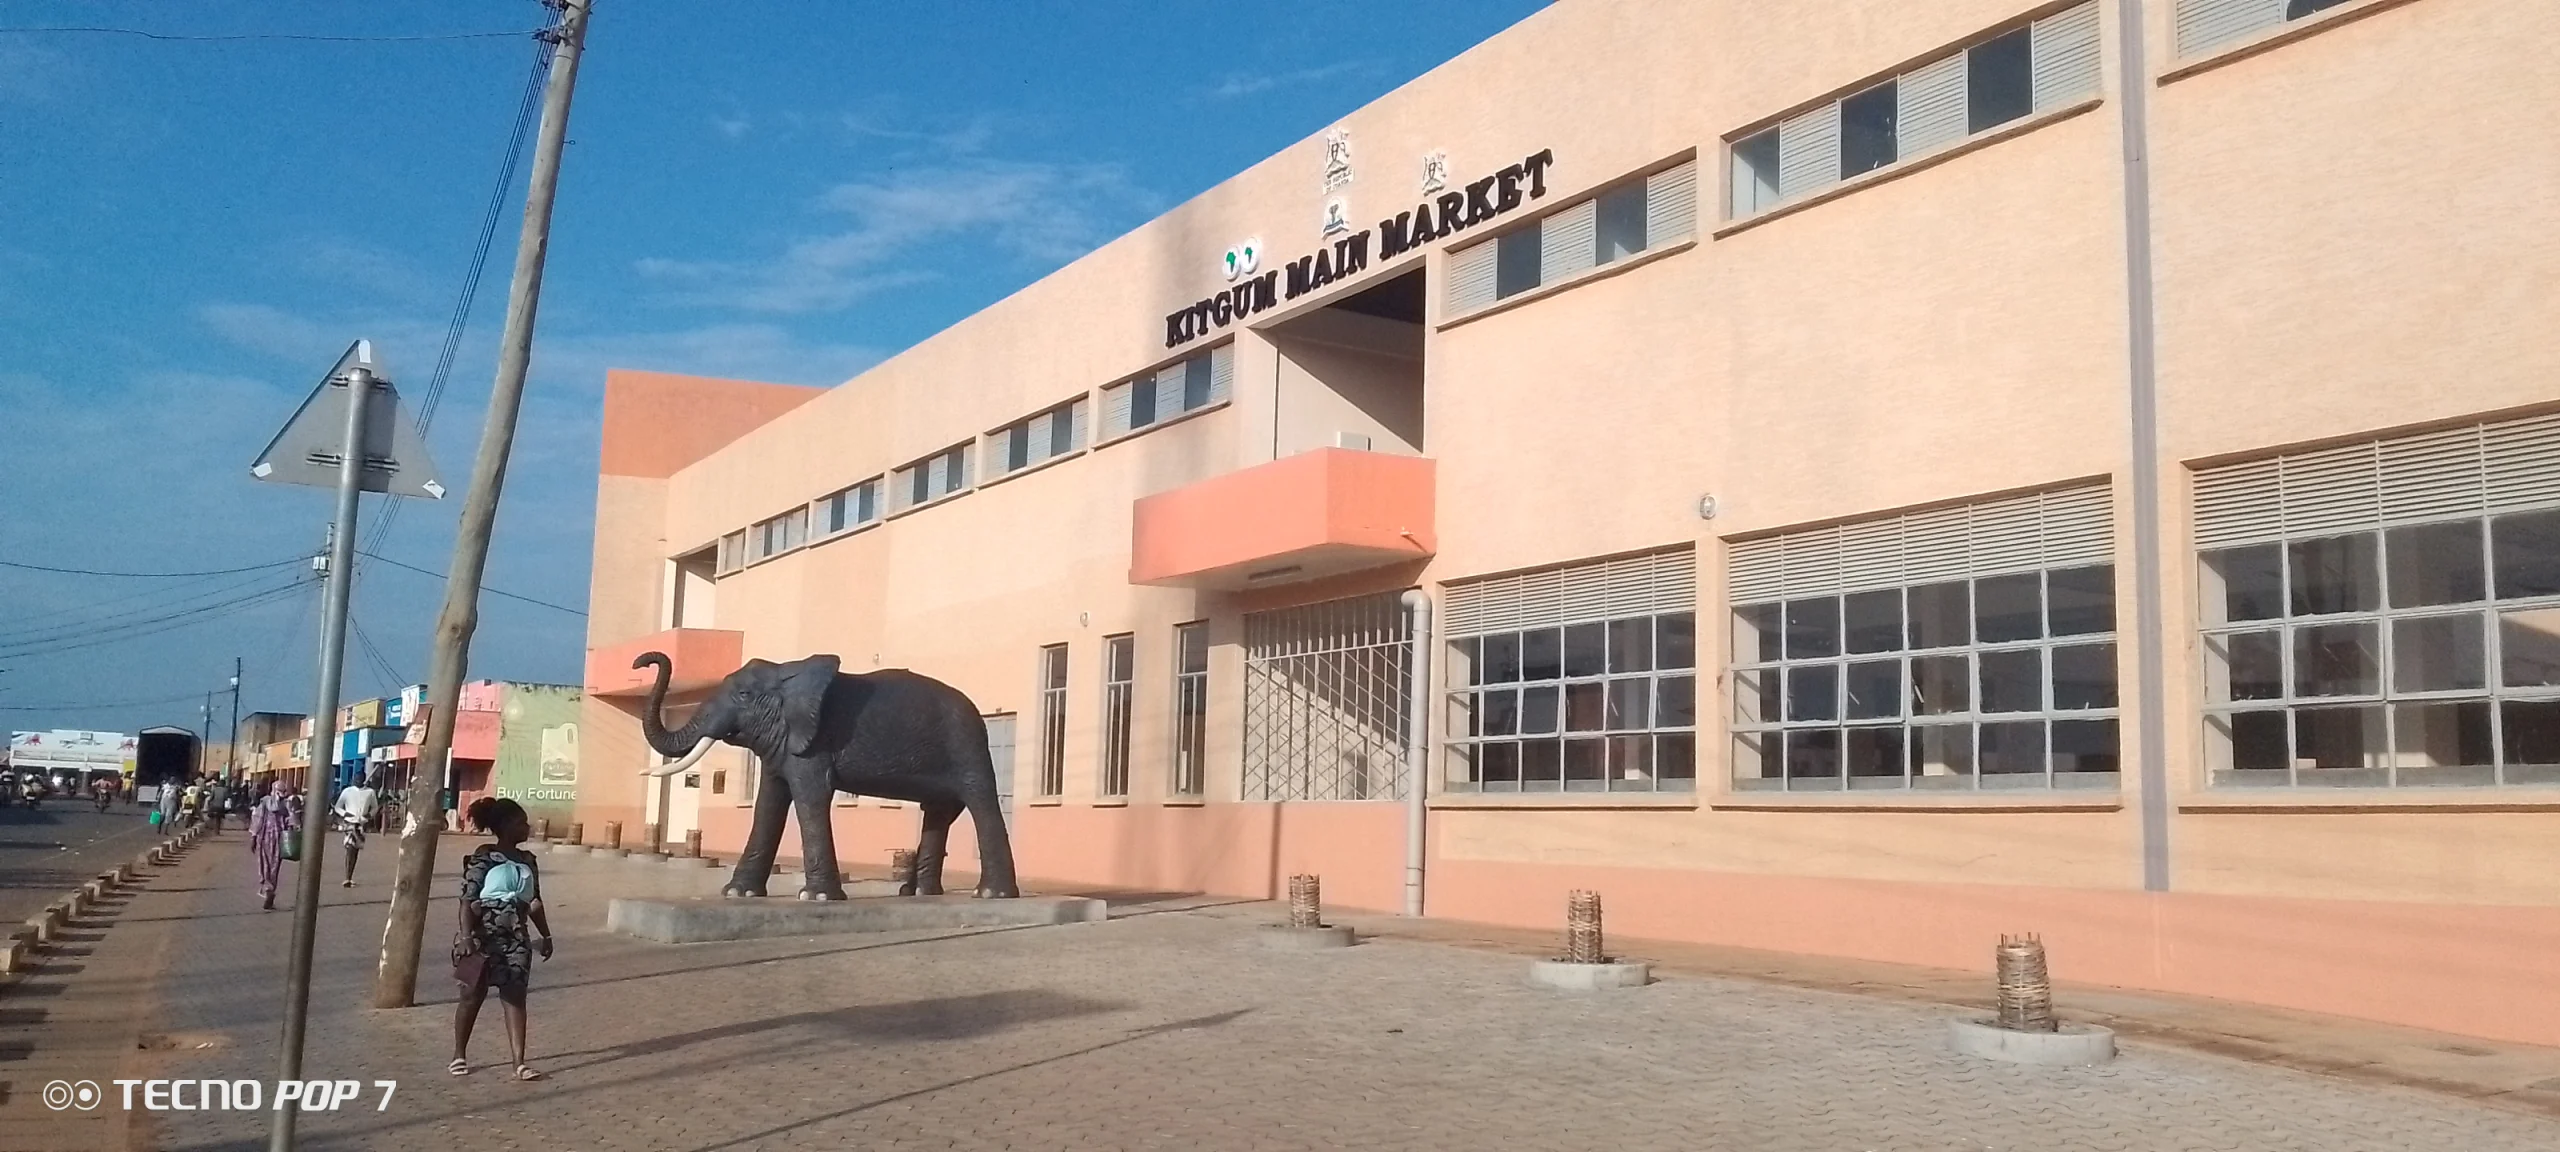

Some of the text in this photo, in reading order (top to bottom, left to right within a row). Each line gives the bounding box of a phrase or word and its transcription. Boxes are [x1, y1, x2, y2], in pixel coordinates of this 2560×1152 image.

[1165, 148, 1553, 349] KITGUM MAIN MARKET
[496, 786, 577, 802] Buy Fortune
